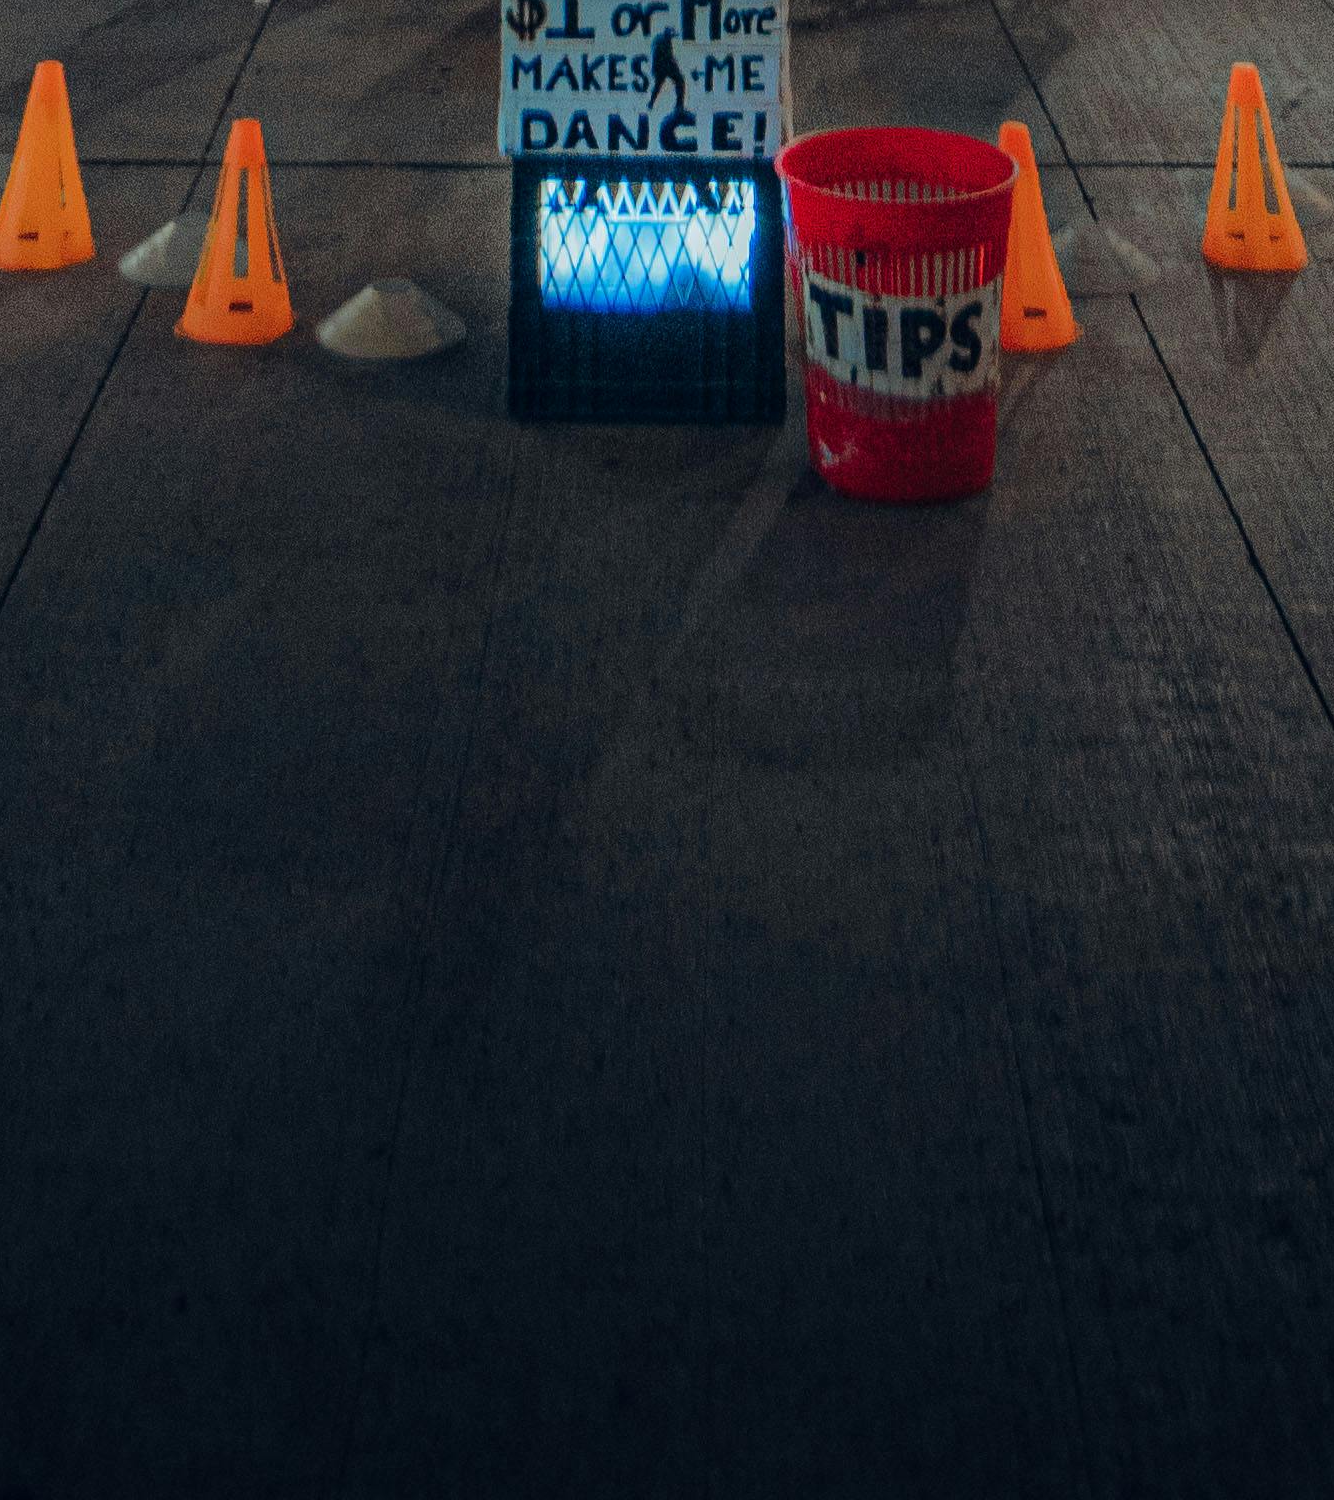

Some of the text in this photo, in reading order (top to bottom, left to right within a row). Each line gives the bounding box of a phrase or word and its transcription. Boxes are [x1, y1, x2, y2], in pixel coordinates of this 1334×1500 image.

[611, 1, 670, 38] or
[511, 53, 767, 93] MAKES ME
[520, 108, 767, 157] DANCE!
[809, 283, 983, 378] TIPS
